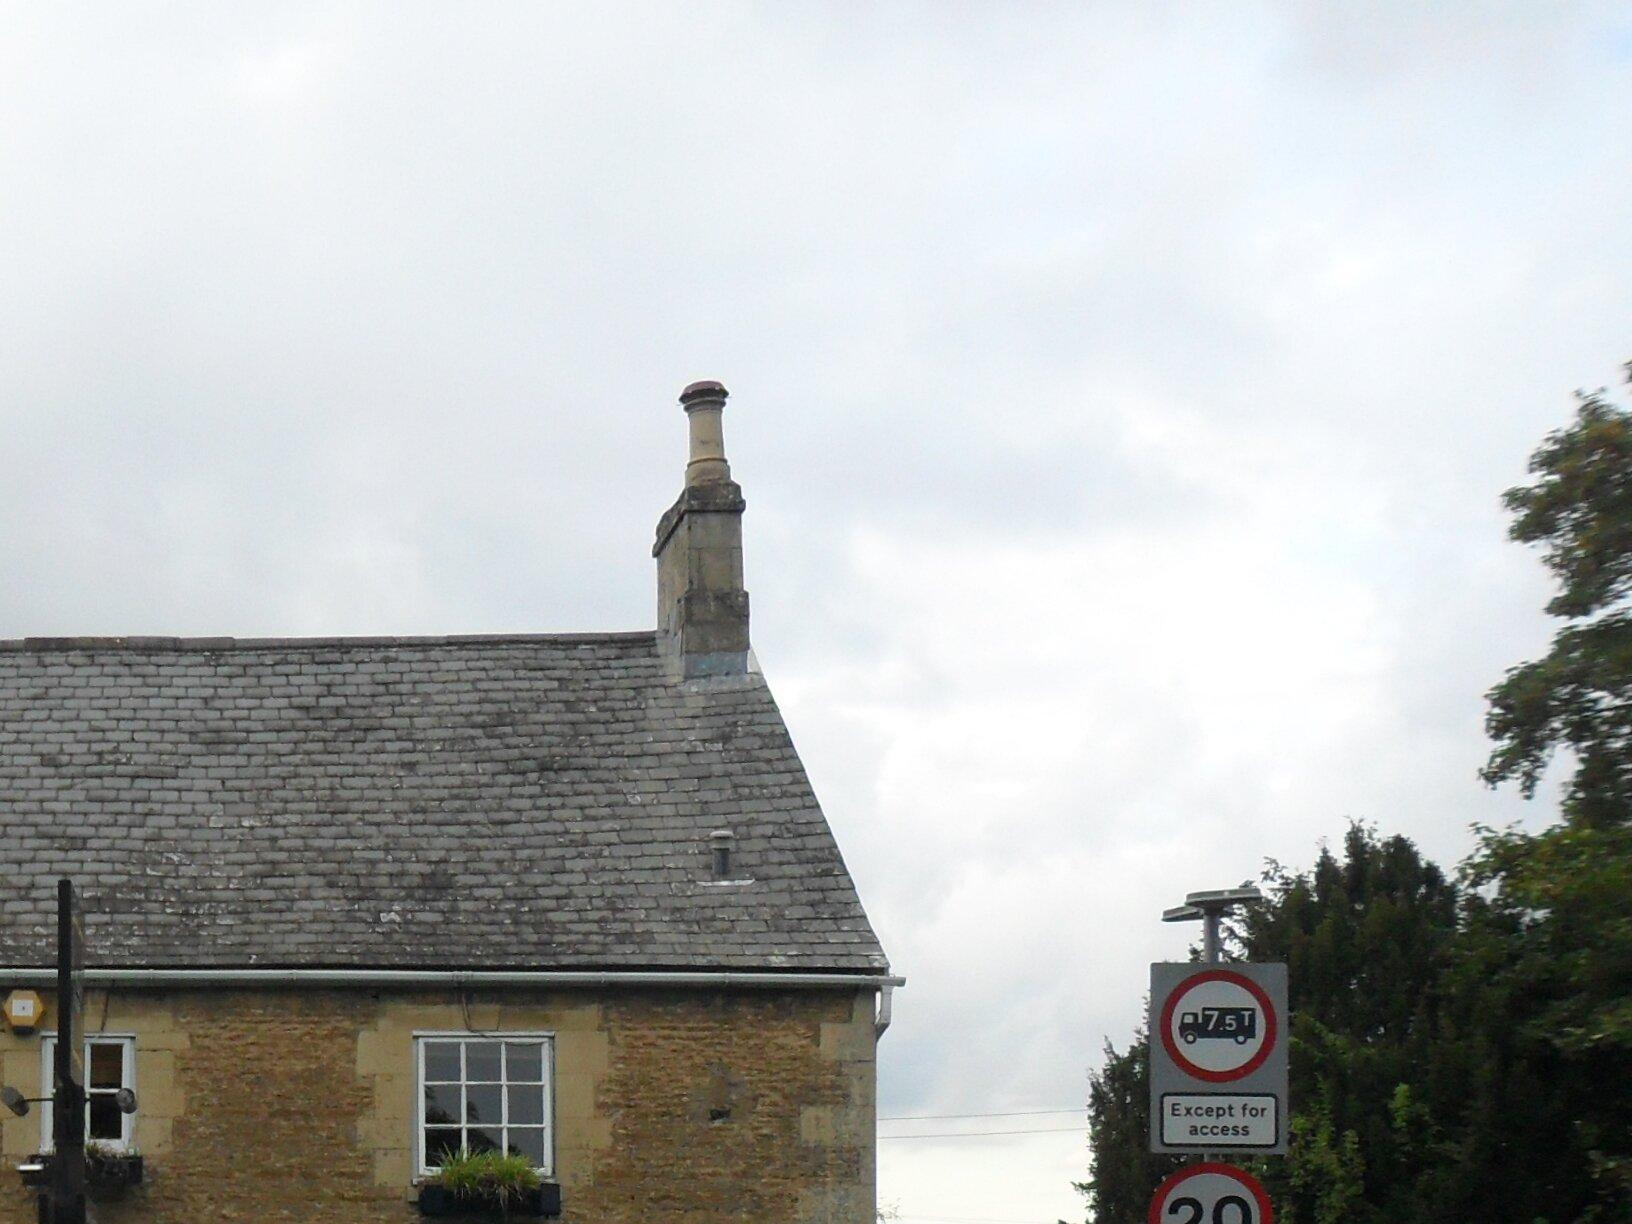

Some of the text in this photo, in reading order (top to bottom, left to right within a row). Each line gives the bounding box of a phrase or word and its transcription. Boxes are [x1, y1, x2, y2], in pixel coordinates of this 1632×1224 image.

[1171, 1103, 1268, 1120] Except for
[1189, 1124, 1250, 1137] access
